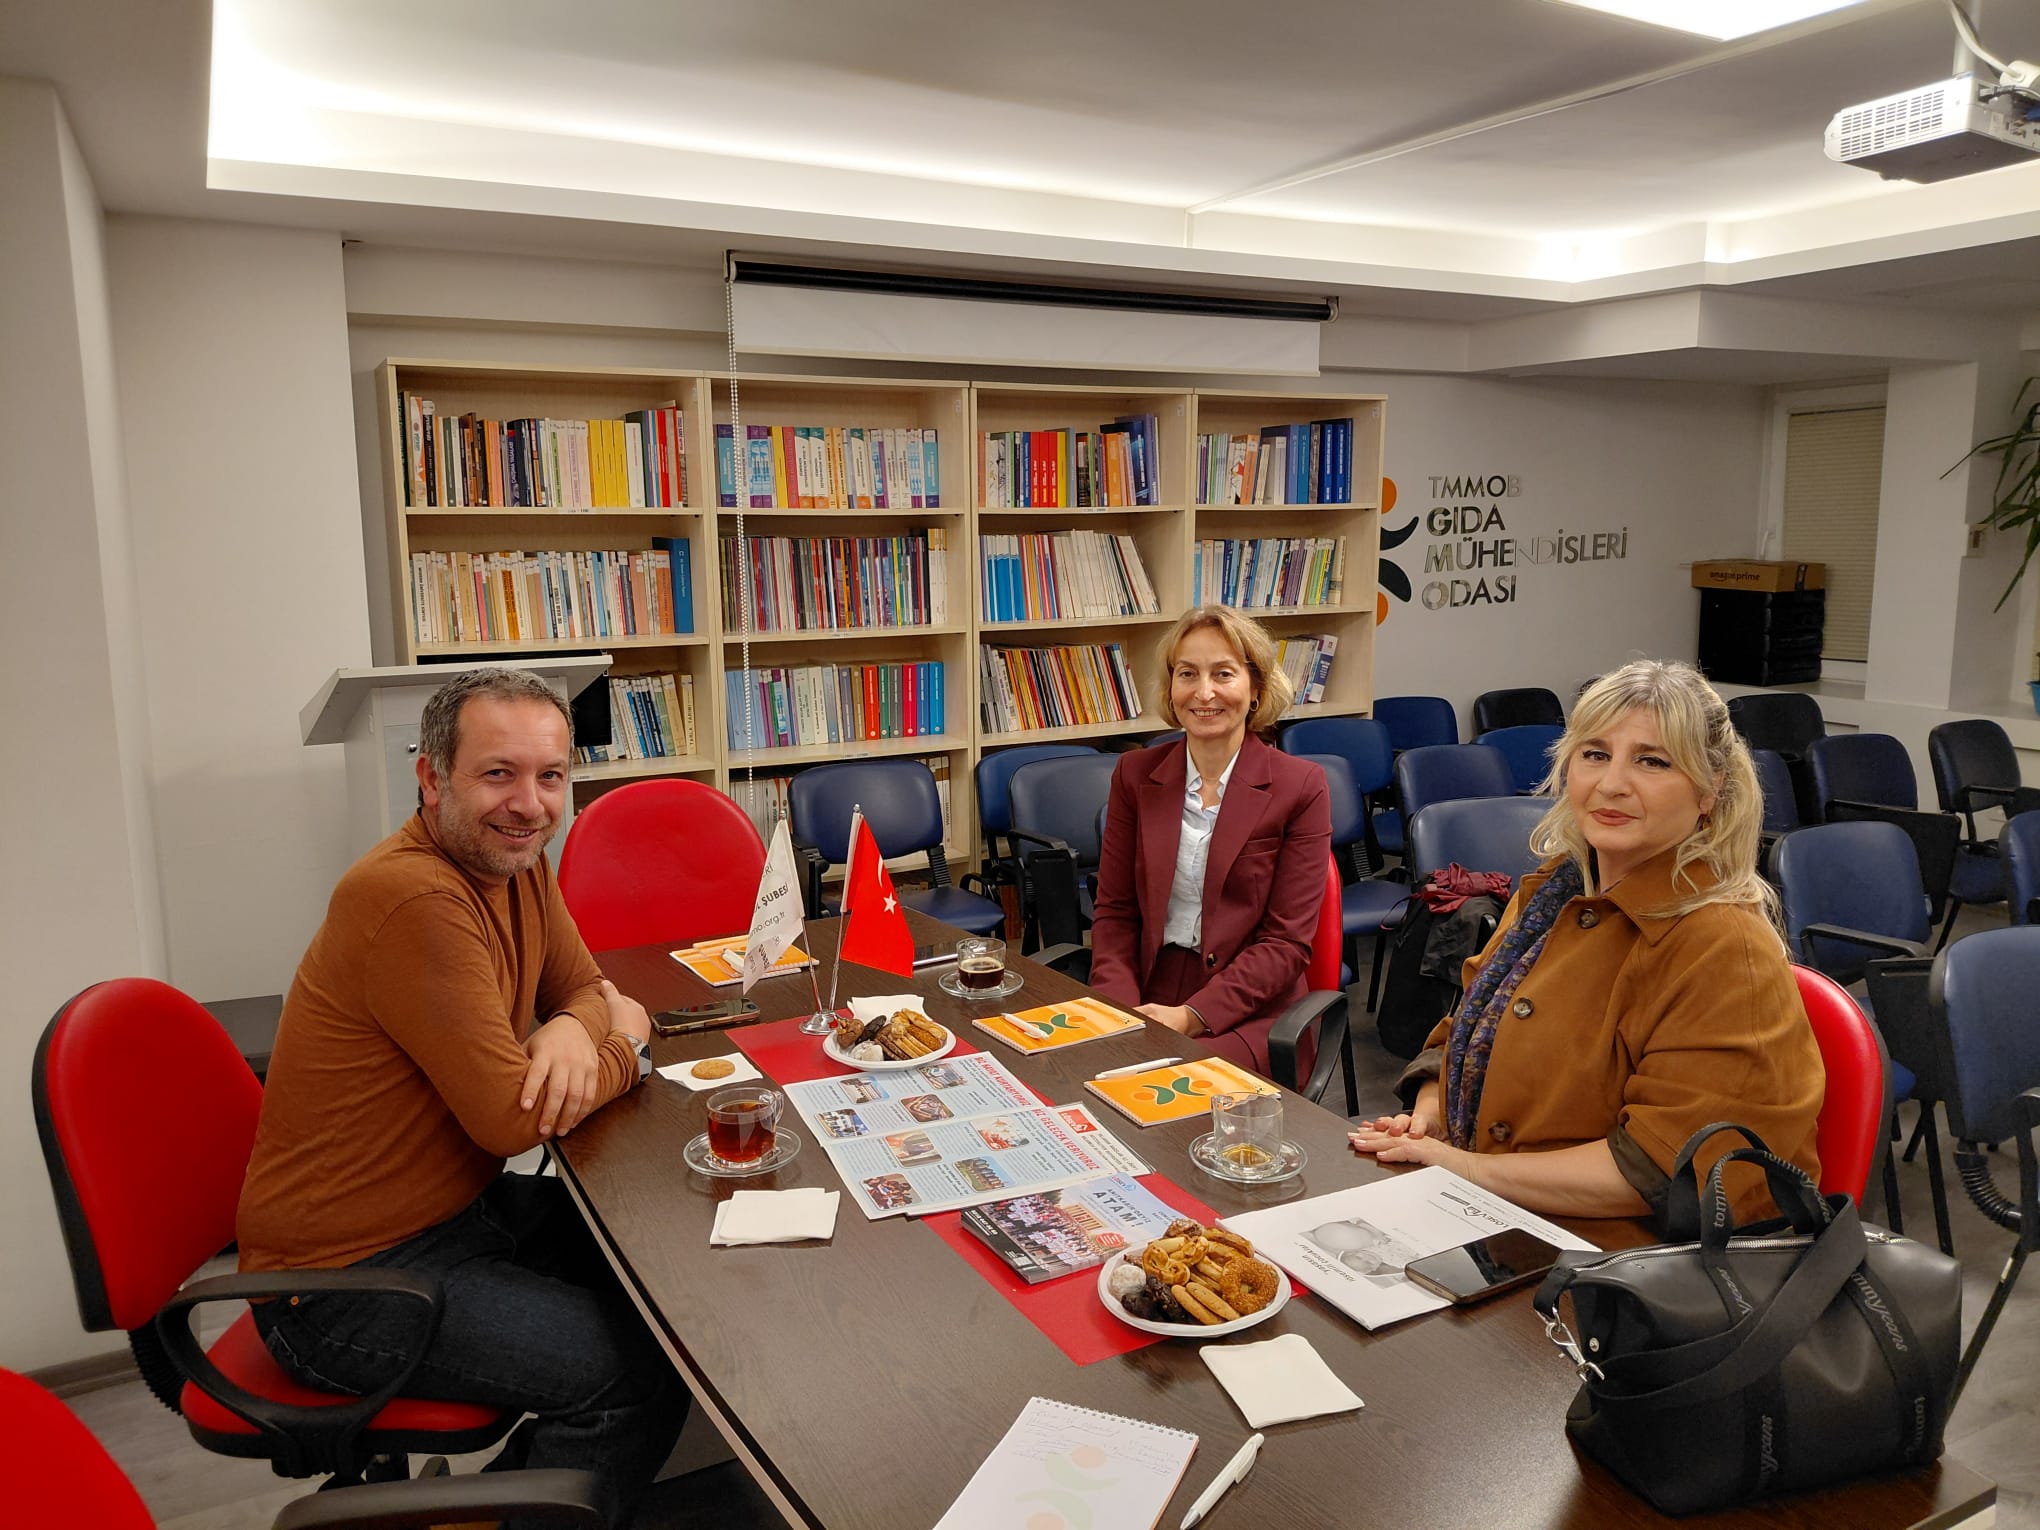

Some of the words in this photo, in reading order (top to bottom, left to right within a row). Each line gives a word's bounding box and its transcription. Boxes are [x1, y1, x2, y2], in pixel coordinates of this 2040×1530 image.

[1427, 474, 1522, 500] TMMOB
[1426, 503, 1506, 536] GIDA
[1423, 527, 1628, 574] MÜHENDİSLERİ
[1421, 575, 1516, 611] ODASI
[1093, 1191, 1144, 1228] ATAM!
